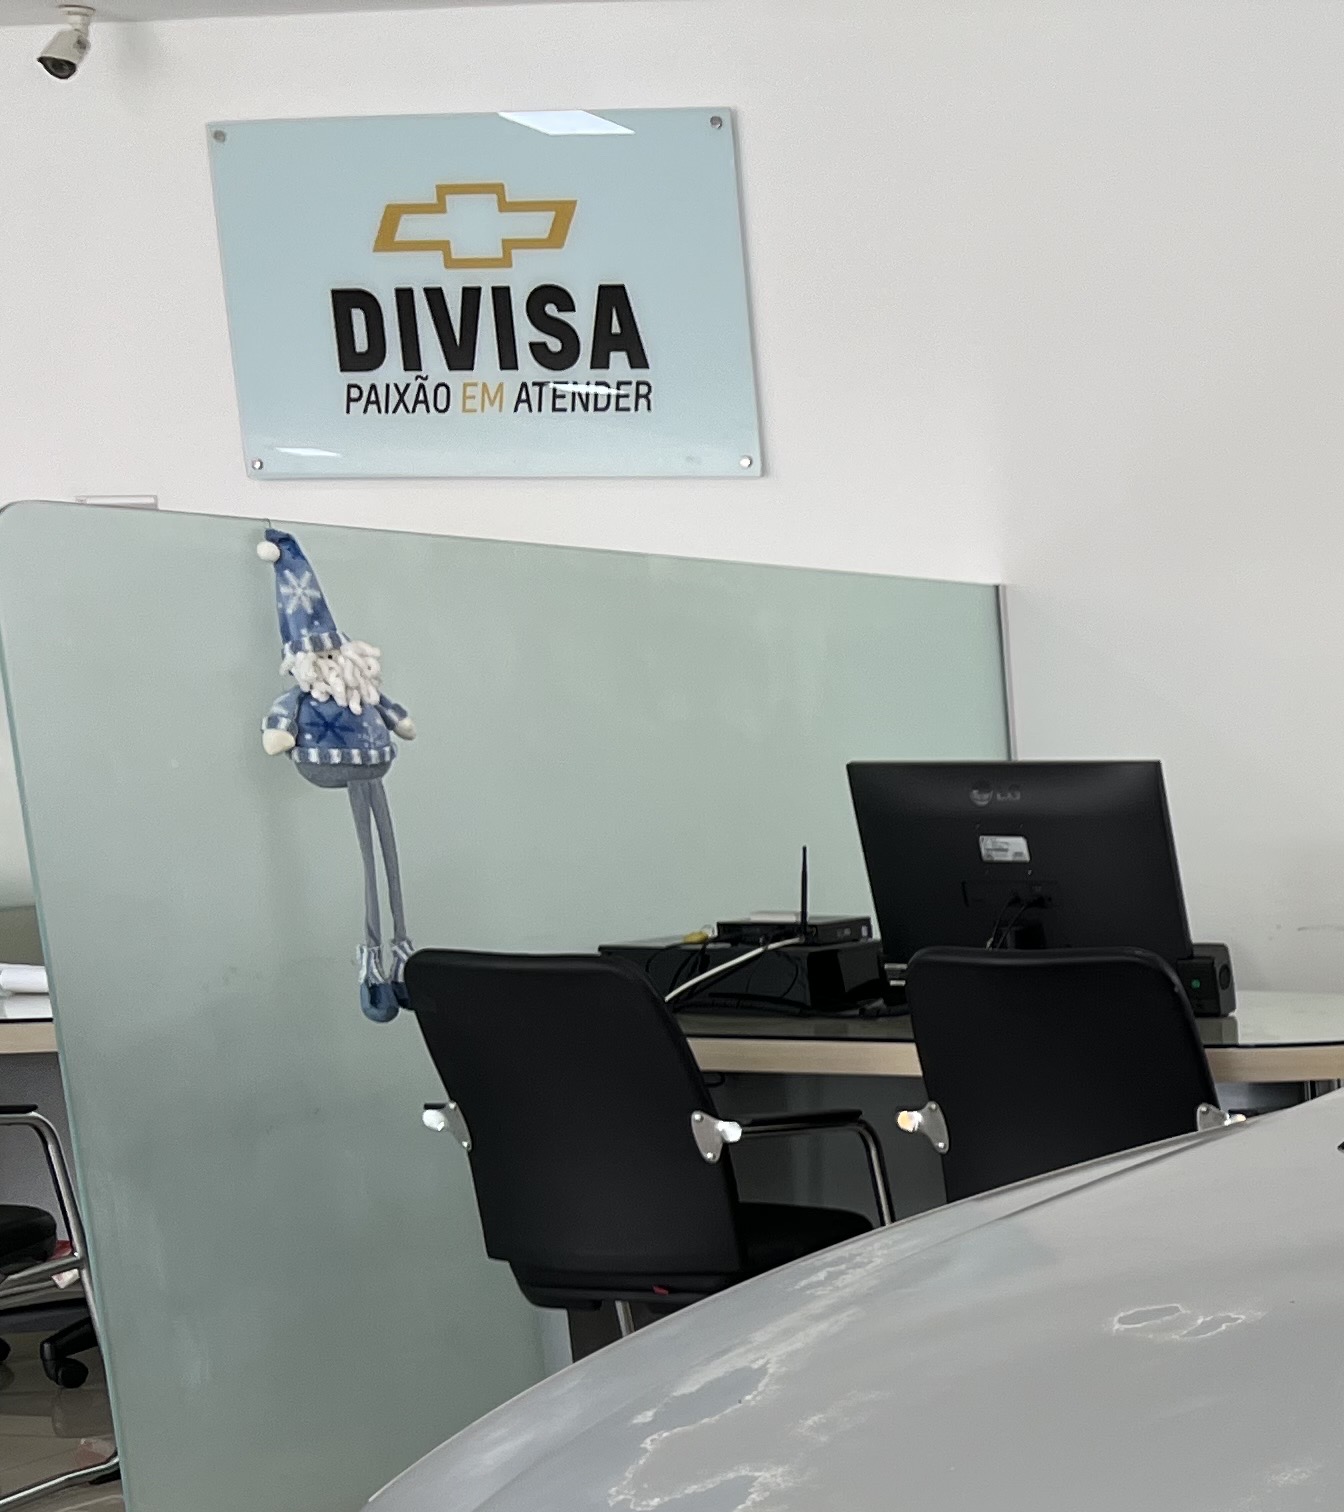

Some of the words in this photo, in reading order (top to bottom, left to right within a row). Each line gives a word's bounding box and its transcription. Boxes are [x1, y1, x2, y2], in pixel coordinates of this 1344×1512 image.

[330, 284, 649, 372] DIVISA
[345, 375, 451, 414] PAIXÃO
[461, 381, 504, 413] EM
[513, 380, 652, 413] ATENDER
